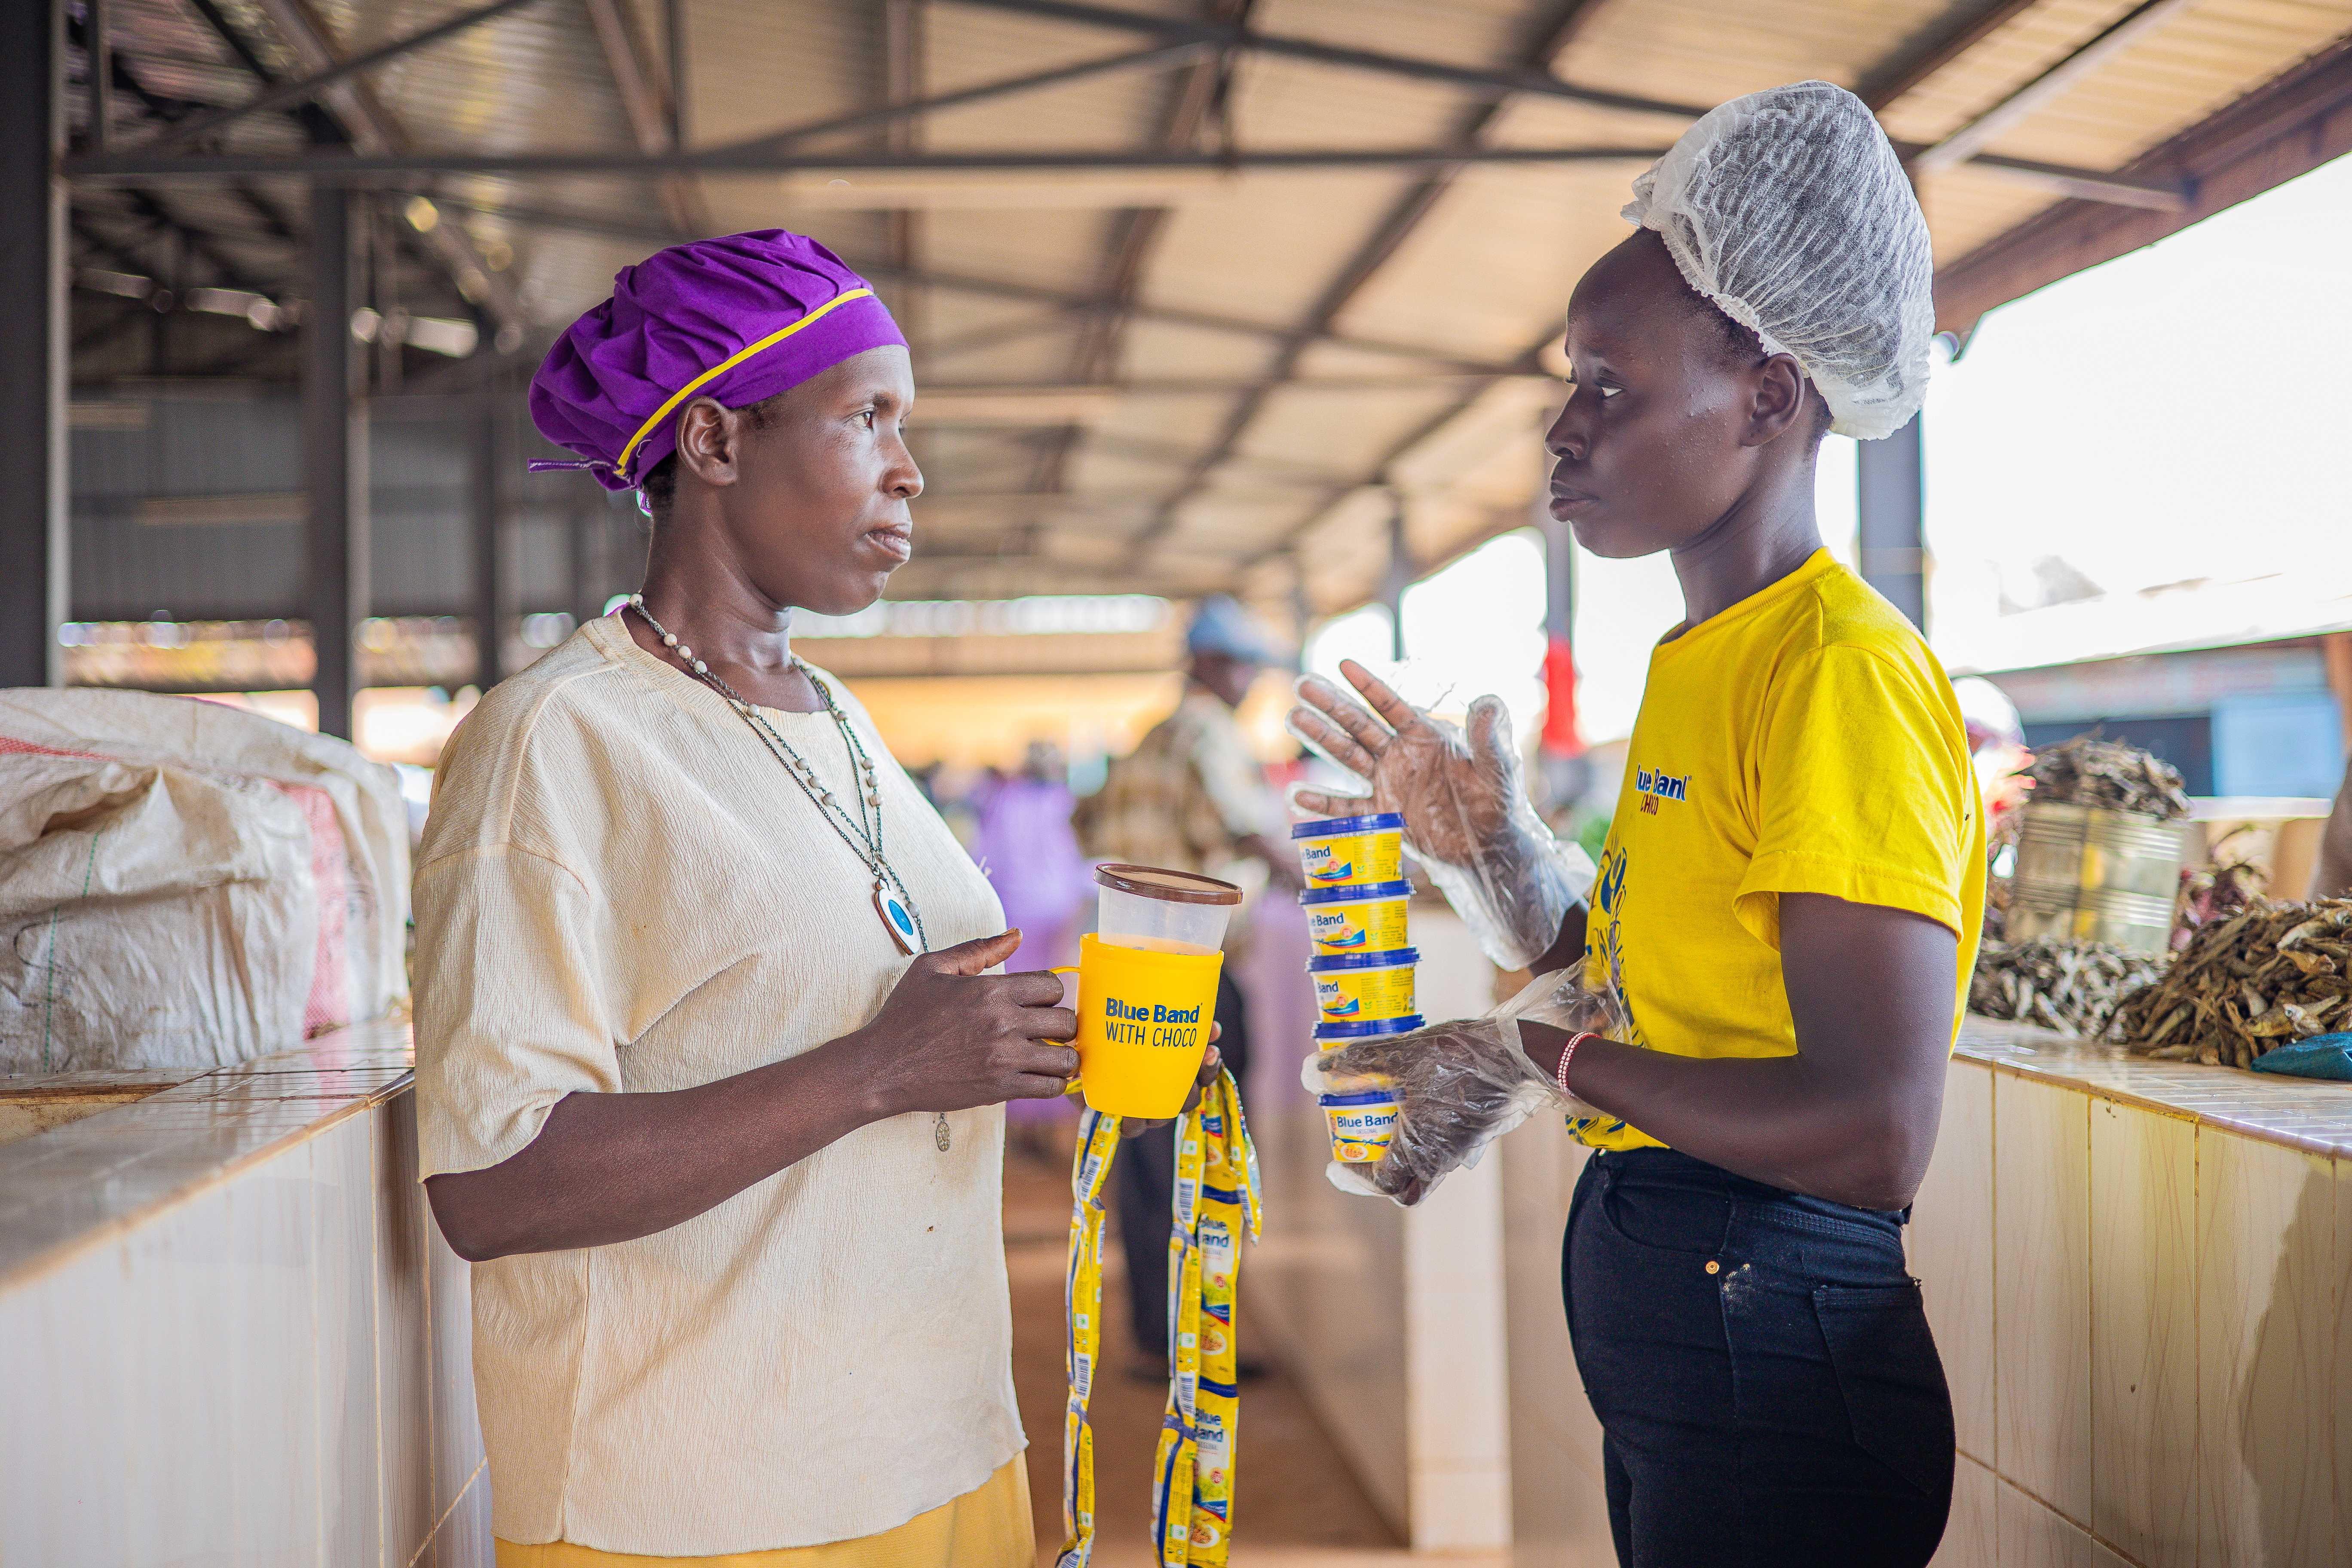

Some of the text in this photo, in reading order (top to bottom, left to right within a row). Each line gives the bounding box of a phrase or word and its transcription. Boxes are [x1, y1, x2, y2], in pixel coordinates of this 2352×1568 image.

[1635, 763, 1652, 793] lue
[1305, 845, 1331, 860] Band
[1316, 912, 1344, 926] Band
[1106, 998, 1200, 1023] Blue Band
[1106, 1021, 1197, 1047] WITH CHOCO
[1337, 1116, 1362, 1127] Blue
[1203, 1233, 1229, 1247] and
[1196, 1427, 1224, 1442] and
